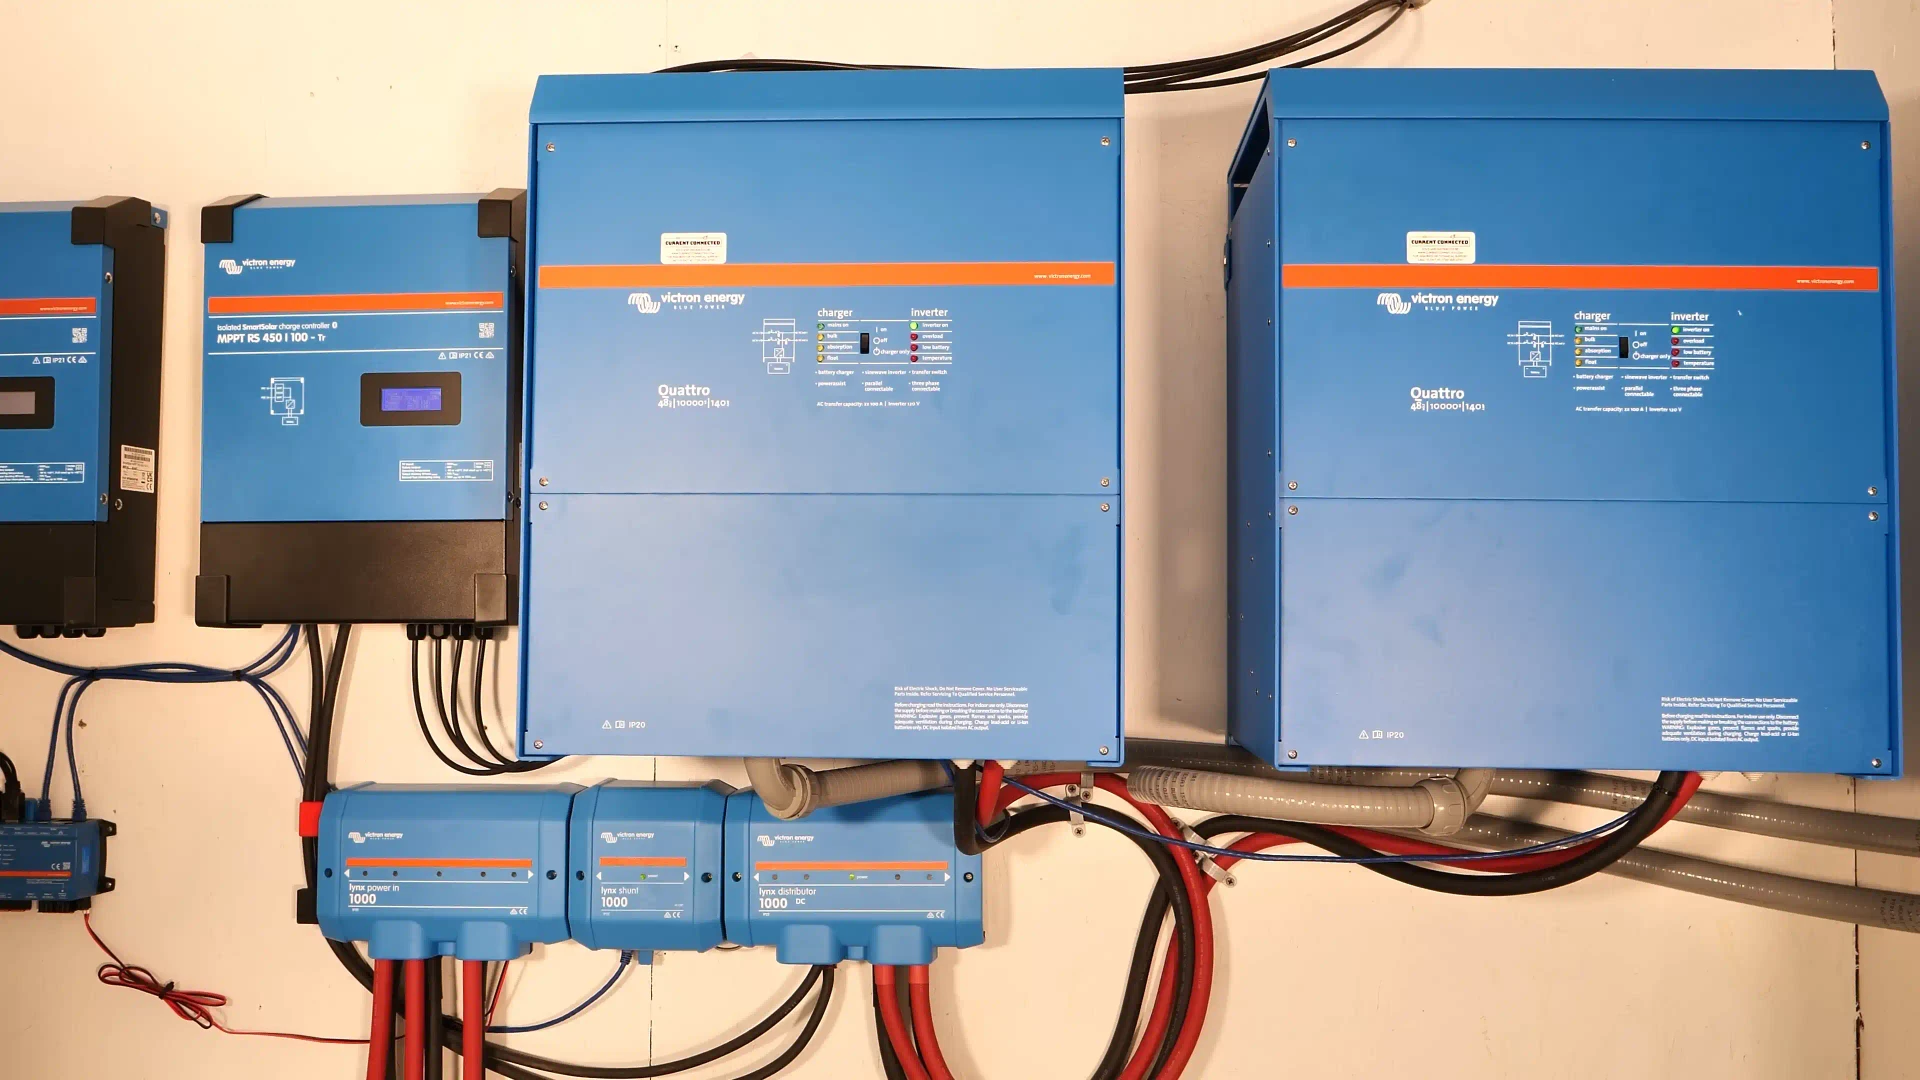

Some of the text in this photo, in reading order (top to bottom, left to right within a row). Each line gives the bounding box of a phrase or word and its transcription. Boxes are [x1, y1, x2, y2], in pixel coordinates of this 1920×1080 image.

[242, 258, 268, 266] victron
[269, 259, 296, 267] energy
[661, 292, 745, 305] victron energy
[1411, 292, 1499, 307] victron energy
[817, 308, 853, 319] charger
[911, 308, 948, 317] inverter
[1574, 311, 1611, 322] charger
[1671, 312, 1709, 321] inverter
[242, 322, 277, 331] SmartSolar
[279, 323, 300, 332] charge
[217, 334, 244, 344] MPPT
[247, 334, 260, 343] RS
[263, 334, 282, 343] 450
[291, 333, 308, 343] 100
[318, 333, 326, 342] Tr
[658, 384, 710, 399] Quattro
[1410, 386, 1464, 402] Quattro
[1387, 731, 1404, 739] IP20
[349, 883, 400, 893] lynx power in
[601, 887, 617, 896] lynx
[759, 887, 816, 897] lynx distributor
[349, 894, 377, 904] 1000
[601, 897, 628, 908] 1000
[759, 898, 788, 909] 1000
